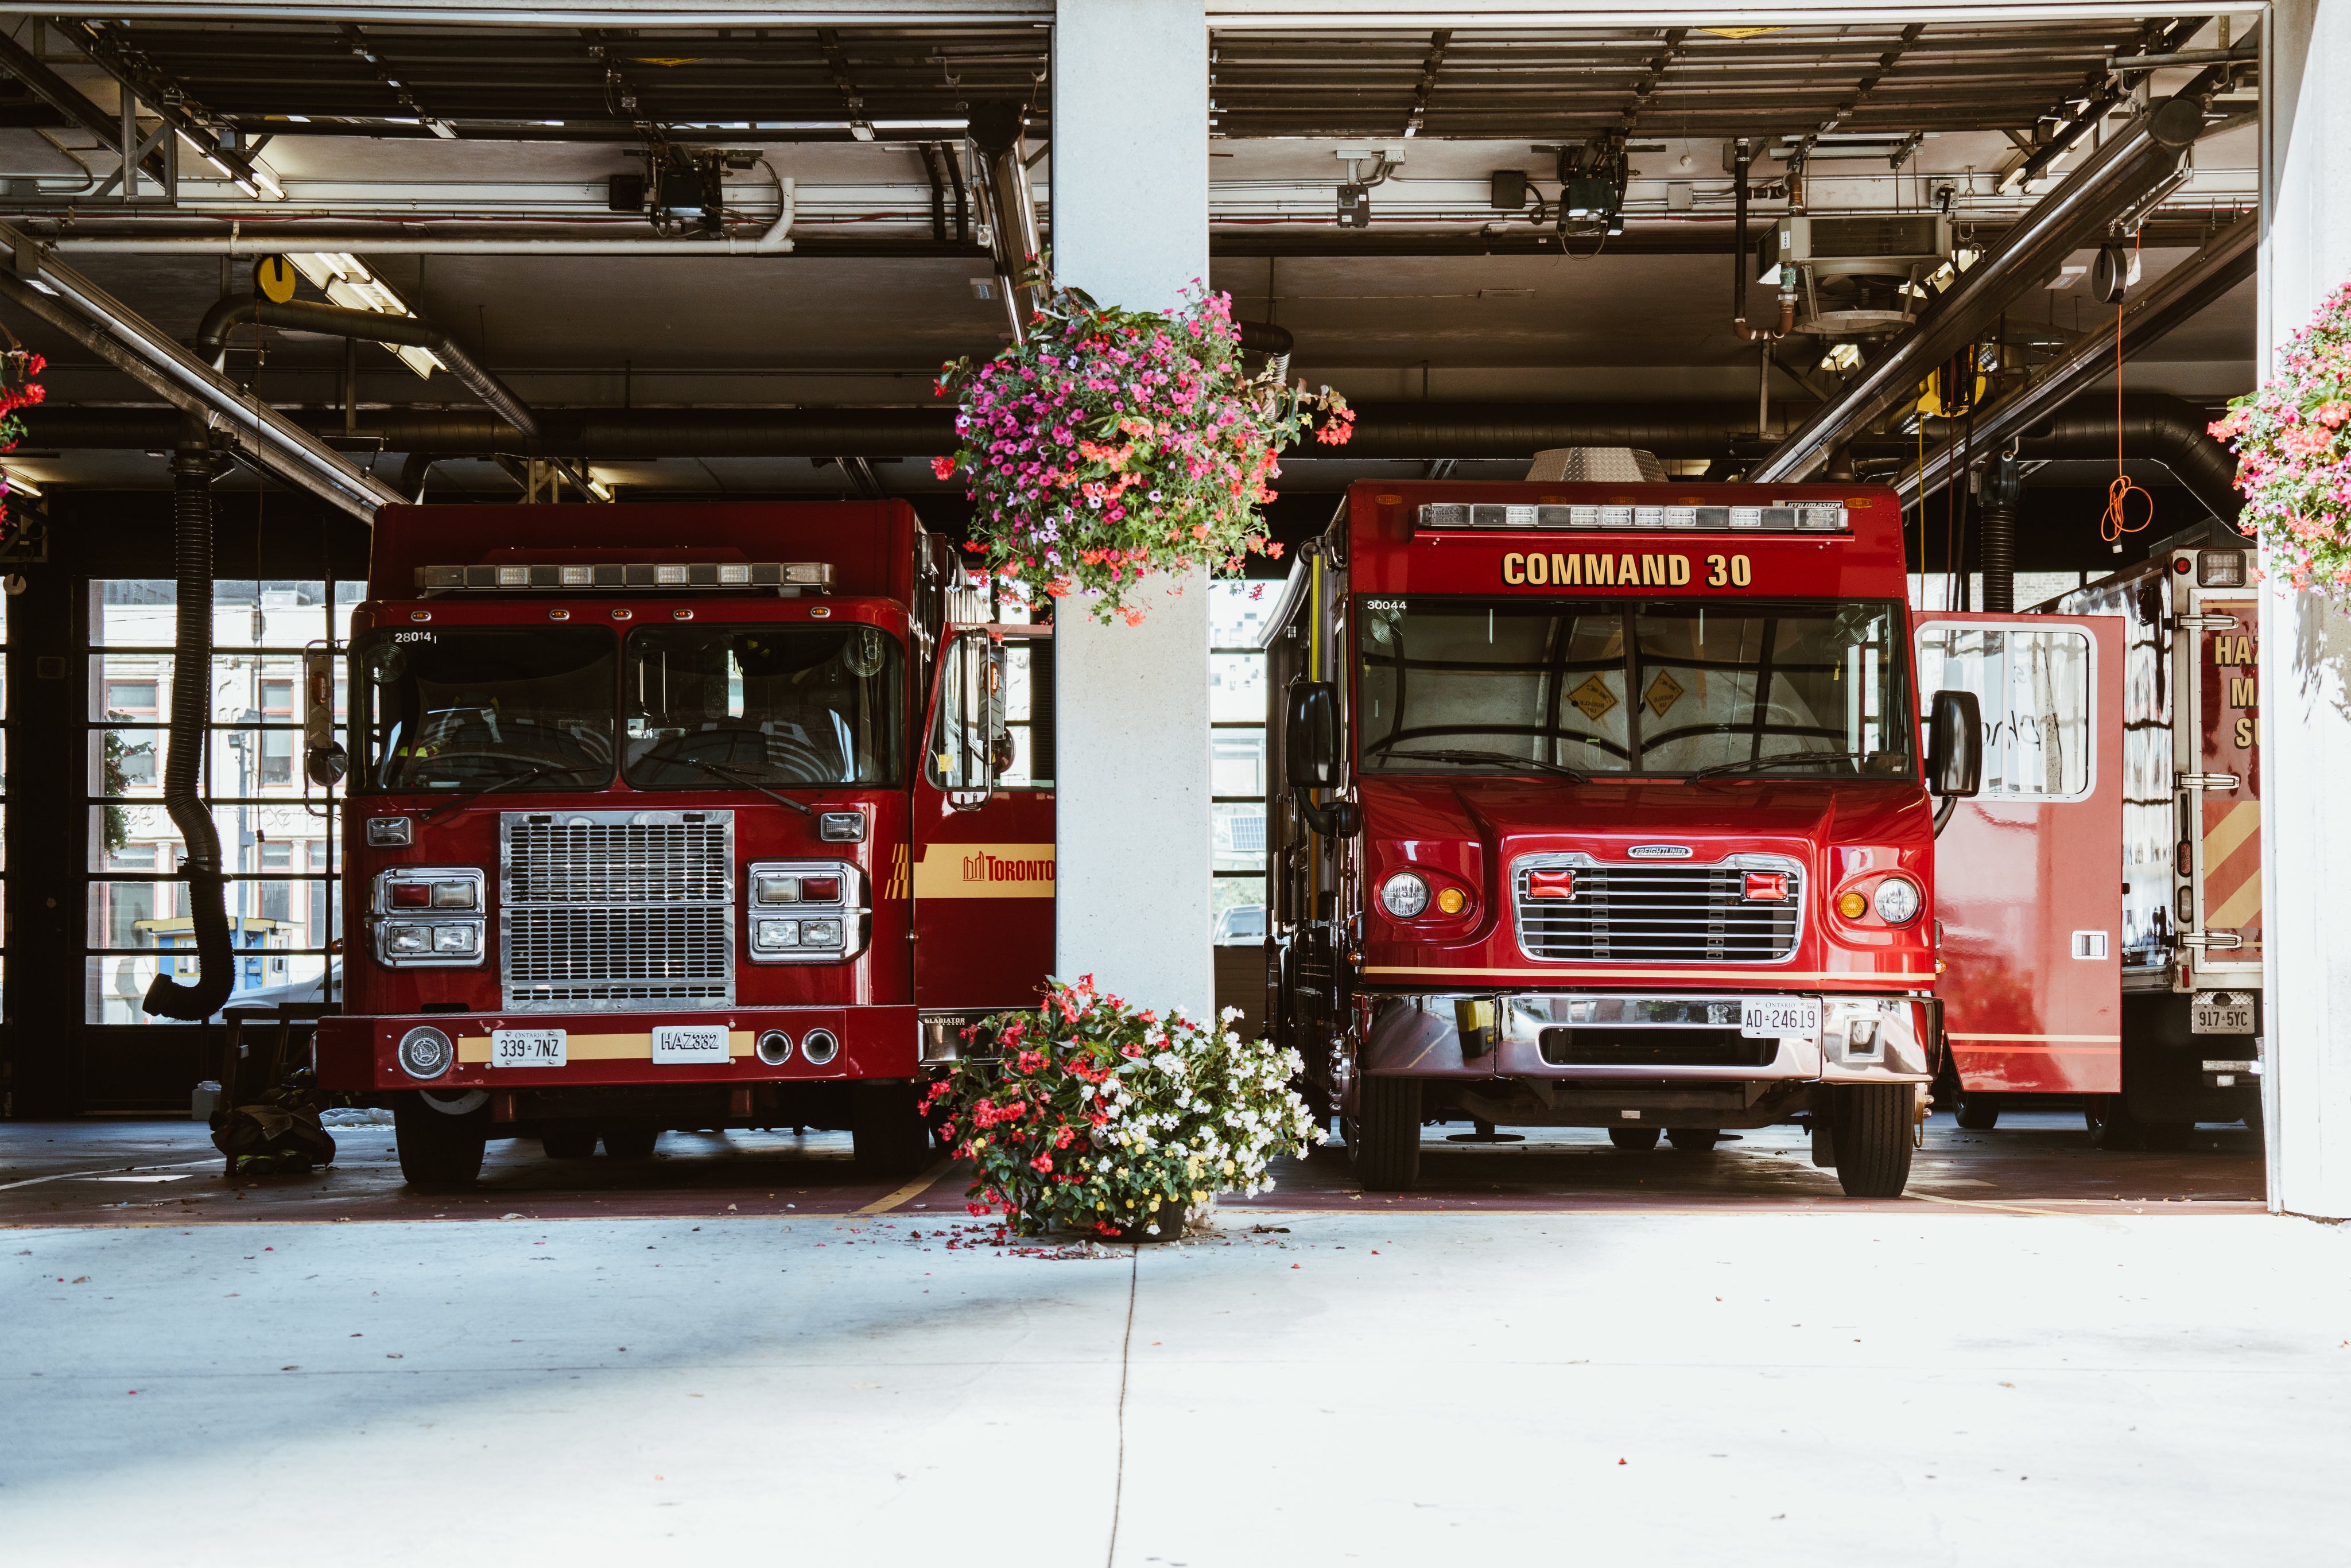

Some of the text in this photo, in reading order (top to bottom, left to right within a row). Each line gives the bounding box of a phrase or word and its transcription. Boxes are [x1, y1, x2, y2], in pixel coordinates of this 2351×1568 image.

[1502, 553, 1752, 588] COMMAND 30
[1367, 600, 1407, 610] 30044
[395, 631, 432, 643] 28014
[2230, 677, 2259, 709] M
[1634, 848, 1686, 856] FREIGHTLINER
[986, 856, 1056, 881] TORONTO
[661, 1032, 719, 1050] HAZ332
